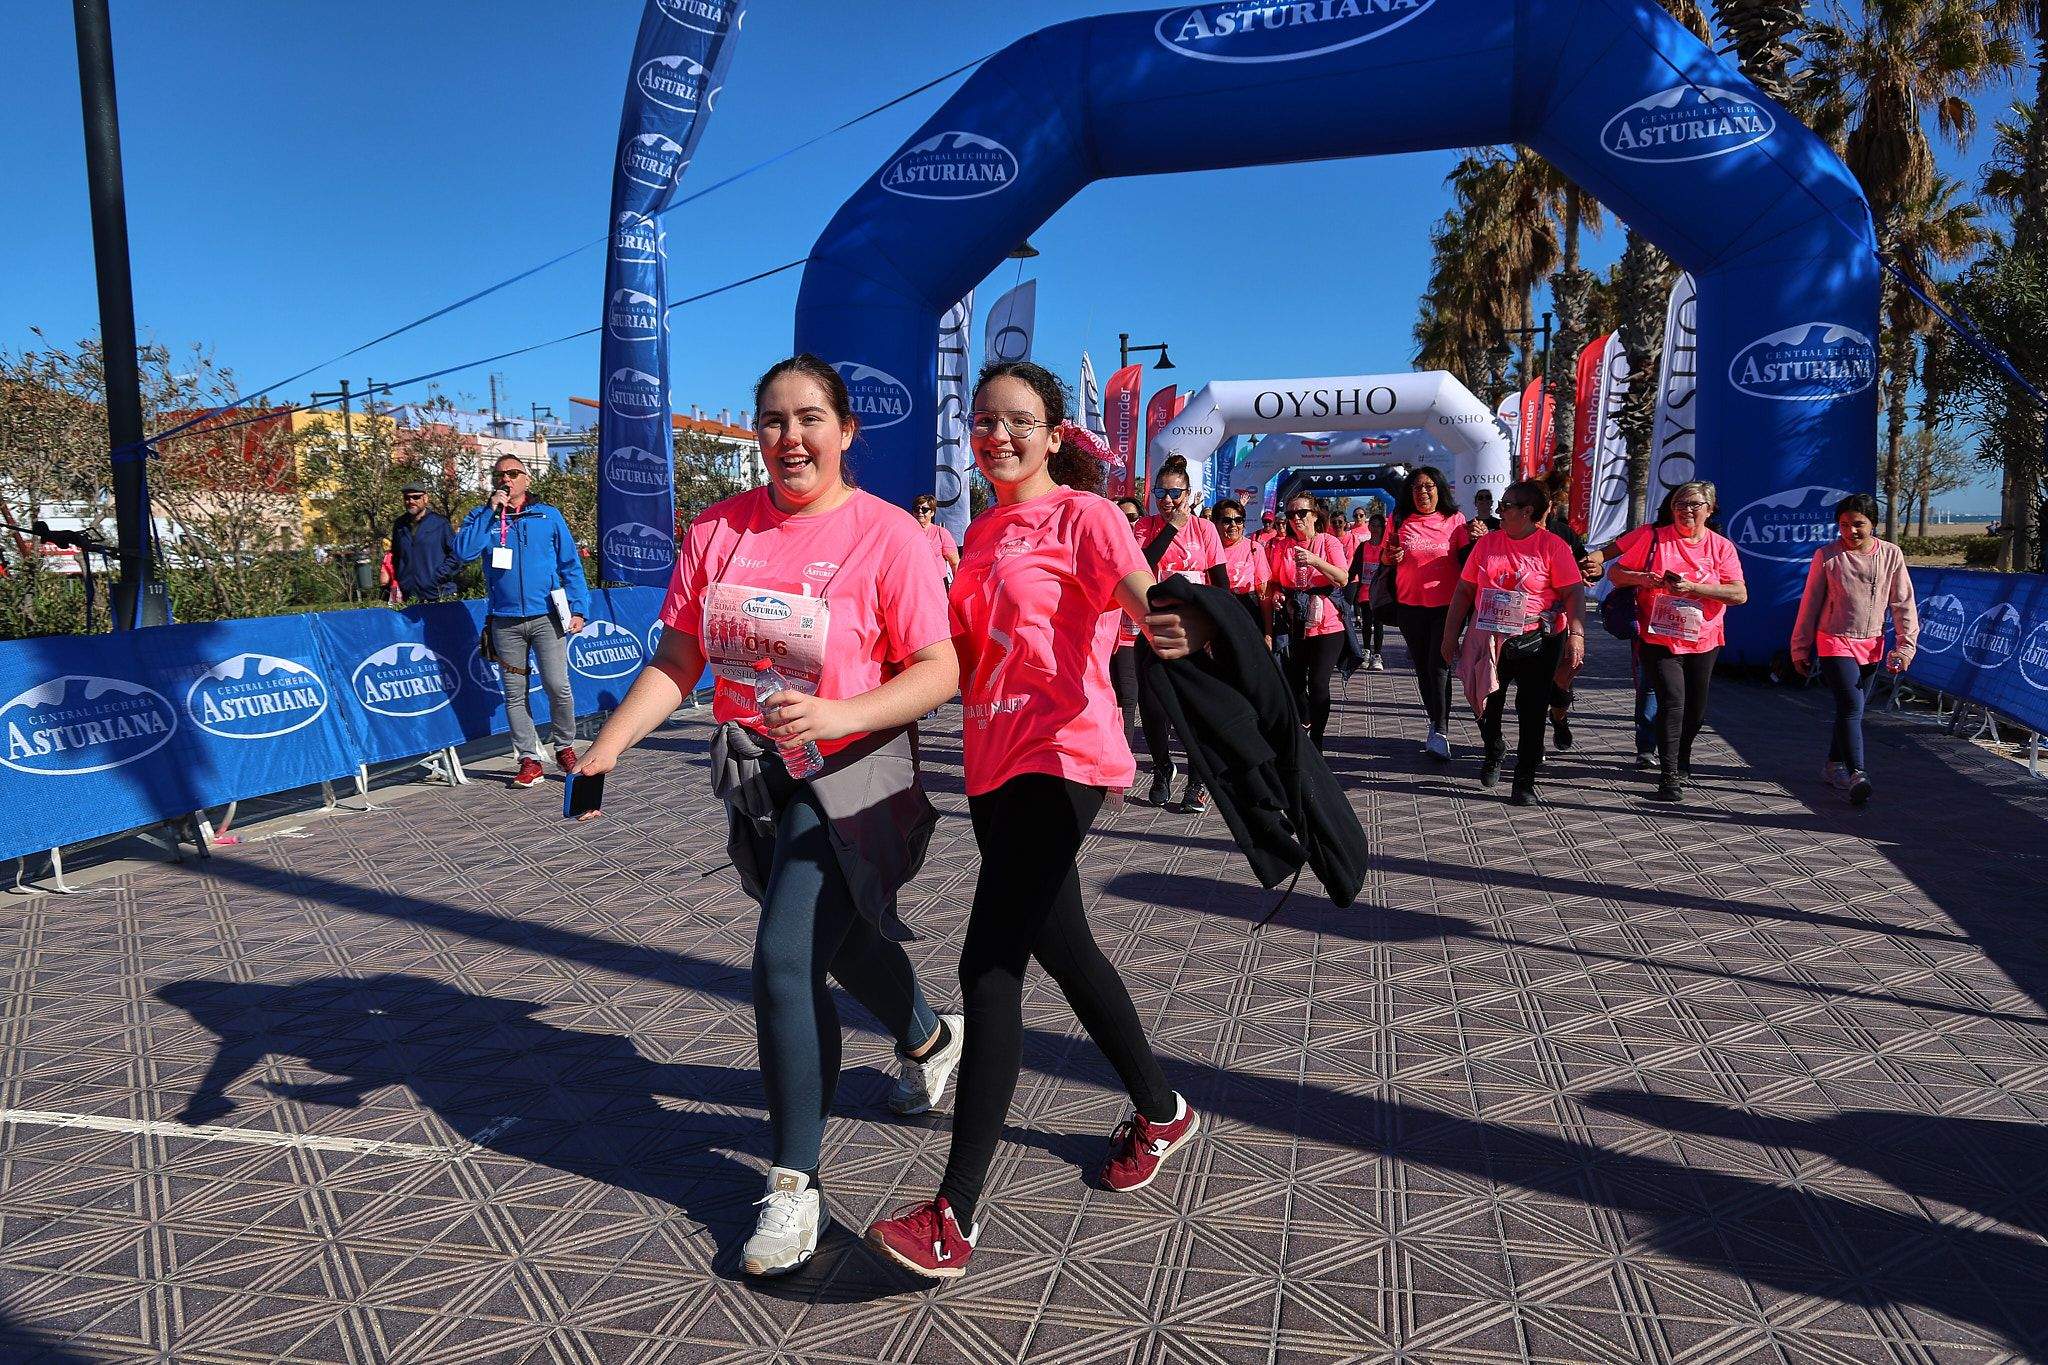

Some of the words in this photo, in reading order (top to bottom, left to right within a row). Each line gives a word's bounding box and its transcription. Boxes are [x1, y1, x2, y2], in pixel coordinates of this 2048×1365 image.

[1641, 109, 1699, 124] CENTRAL
[1614, 115, 1766, 150] ASTURIANA
[908, 153, 952, 164] CENTRAL
[956, 152, 1003, 161] LECHERA
[887, 163, 1007, 185] ASTURIANA
[1765, 349, 1823, 360] CENTRAL
[1739, 355, 1871, 385] ASTURIANA
[848, 396, 904, 415] RIANA
[1254, 386, 1397, 419] OYSHO
[1583, 358, 1602, 445] Santander
[1439, 413, 1484, 426] OYSHO
[1172, 426, 1213, 436] OYSHO
[609, 461, 670, 486] ASTURIANA
[1310, 474, 1377, 482] VOLVO
[1463, 474, 1506, 485] OYSHO
[1763, 512, 1820, 521] CENTRAL
[1738, 516, 1841, 544] ASTURI
[606, 536, 672, 562] ASTURIANA
[731, 555, 768, 569] YSHO
[745, 602, 788, 617] ASTURIANA
[575, 644, 640, 668] ASTURIANA
[744, 636, 788, 656] 016
[376, 667, 415, 679] CENTRAL
[722, 667, 757, 680] OYSHO
[217, 682, 264, 696] CENTRAL
[266, 676, 310, 688] LECHERA
[28, 707, 91, 726] CENTRAL
[96, 697, 154, 714] LECHERA
[203, 687, 321, 724] ASTURIANA
[8, 710, 168, 760] ASTURIANA
